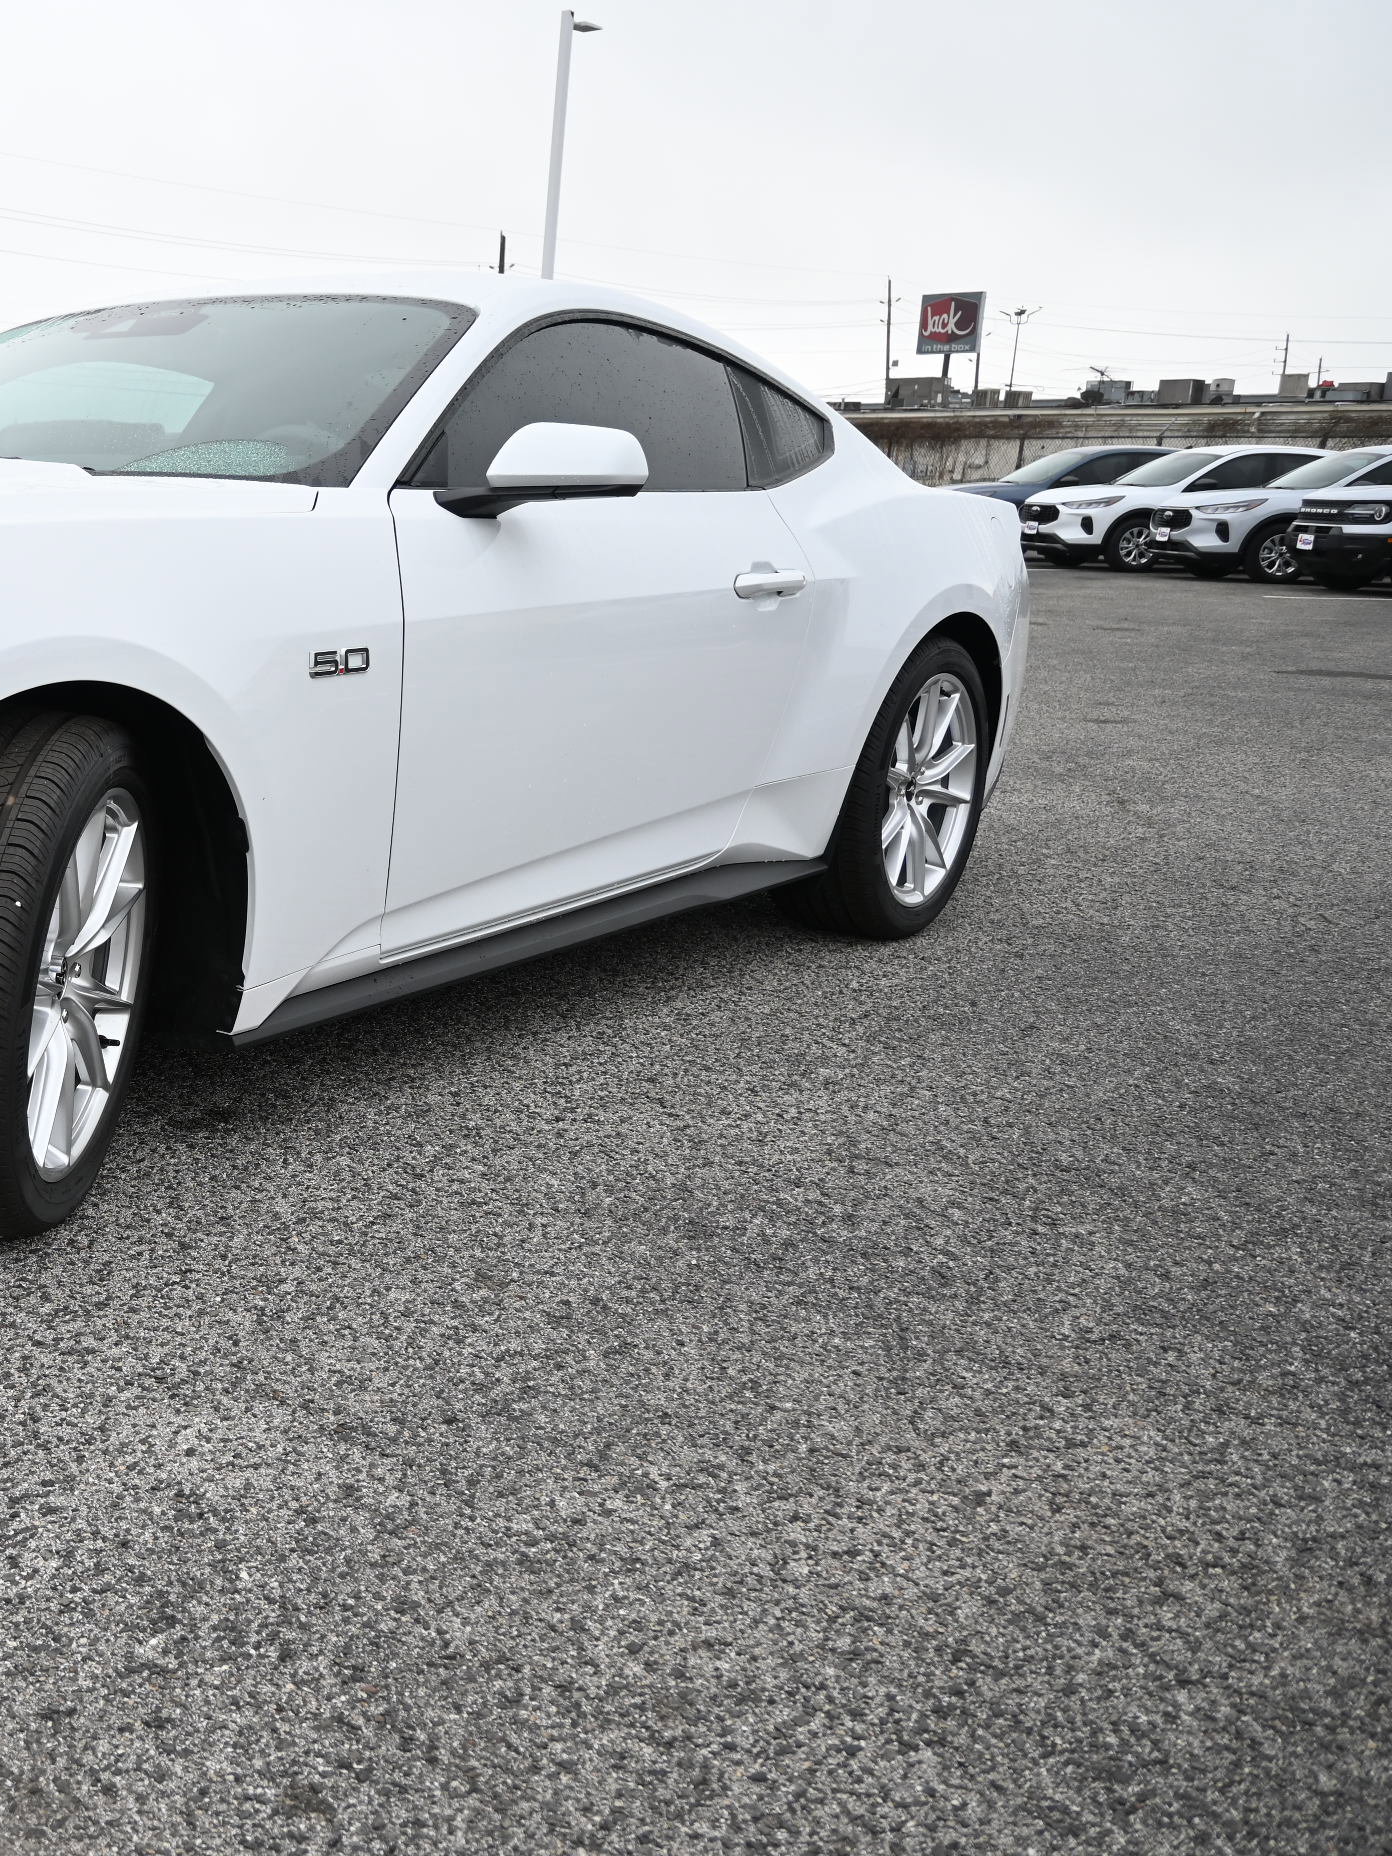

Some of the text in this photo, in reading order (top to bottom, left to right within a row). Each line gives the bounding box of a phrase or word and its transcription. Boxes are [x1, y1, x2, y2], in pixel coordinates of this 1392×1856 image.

[922, 301, 974, 336] Jack
[922, 344, 931, 352] in
[933, 344, 949, 352] the
[309, 647, 370, 679] 5.0
